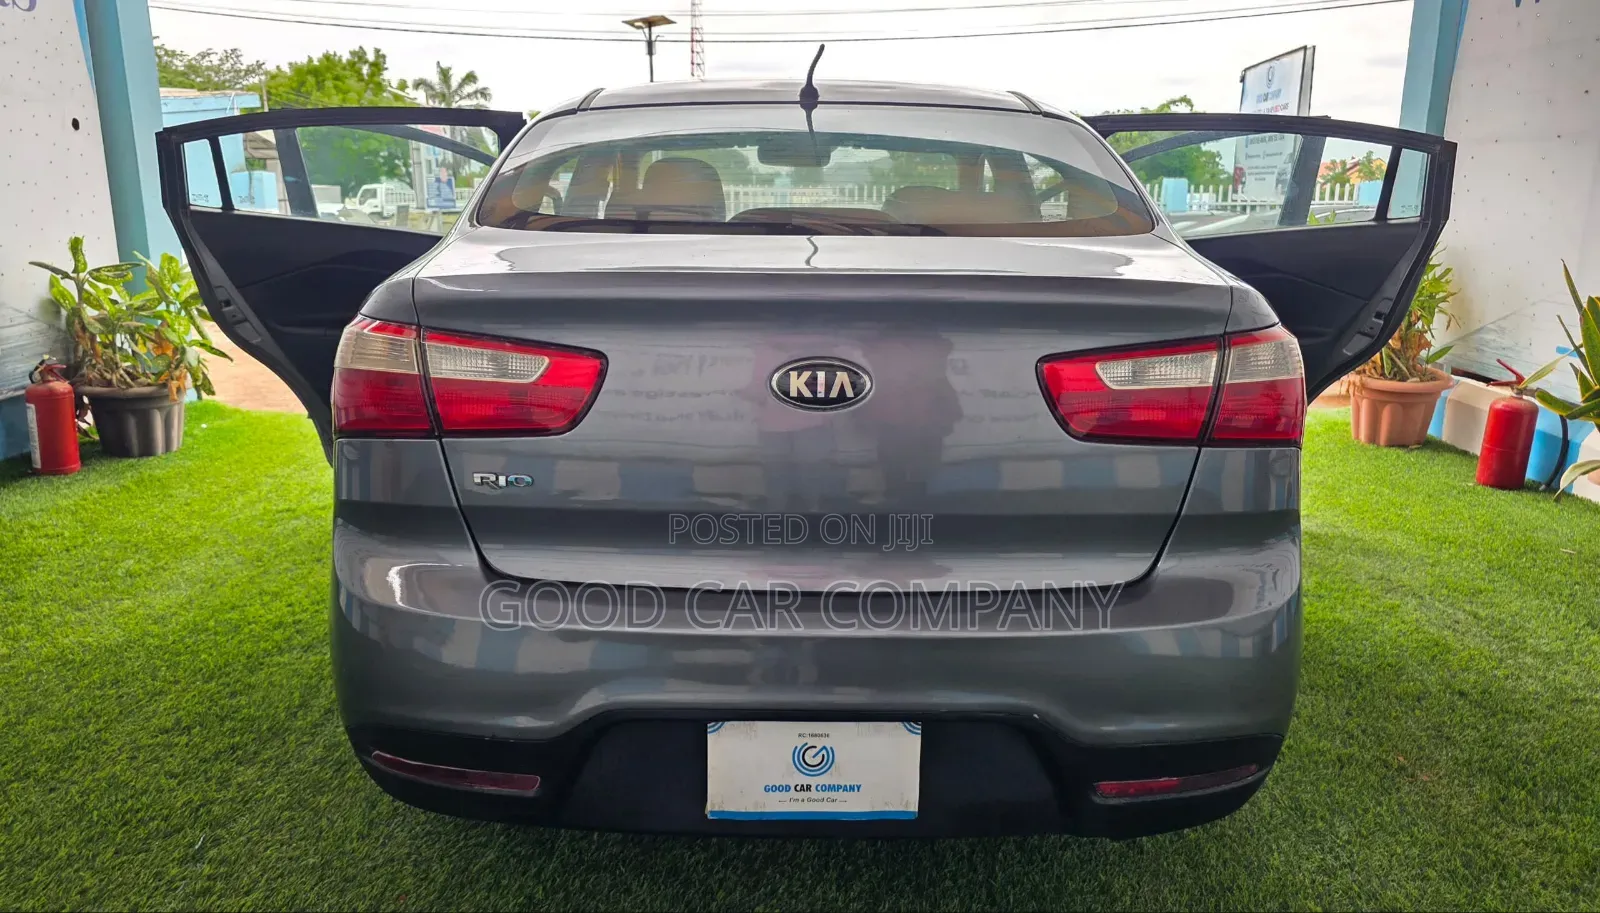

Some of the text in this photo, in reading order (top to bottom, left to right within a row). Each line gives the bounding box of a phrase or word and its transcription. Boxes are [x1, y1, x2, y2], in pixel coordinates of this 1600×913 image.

[789, 371, 854, 398] KIA
[473, 472, 534, 490] RIO
[764, 784, 862, 793] GOOD CAR COMPANY
